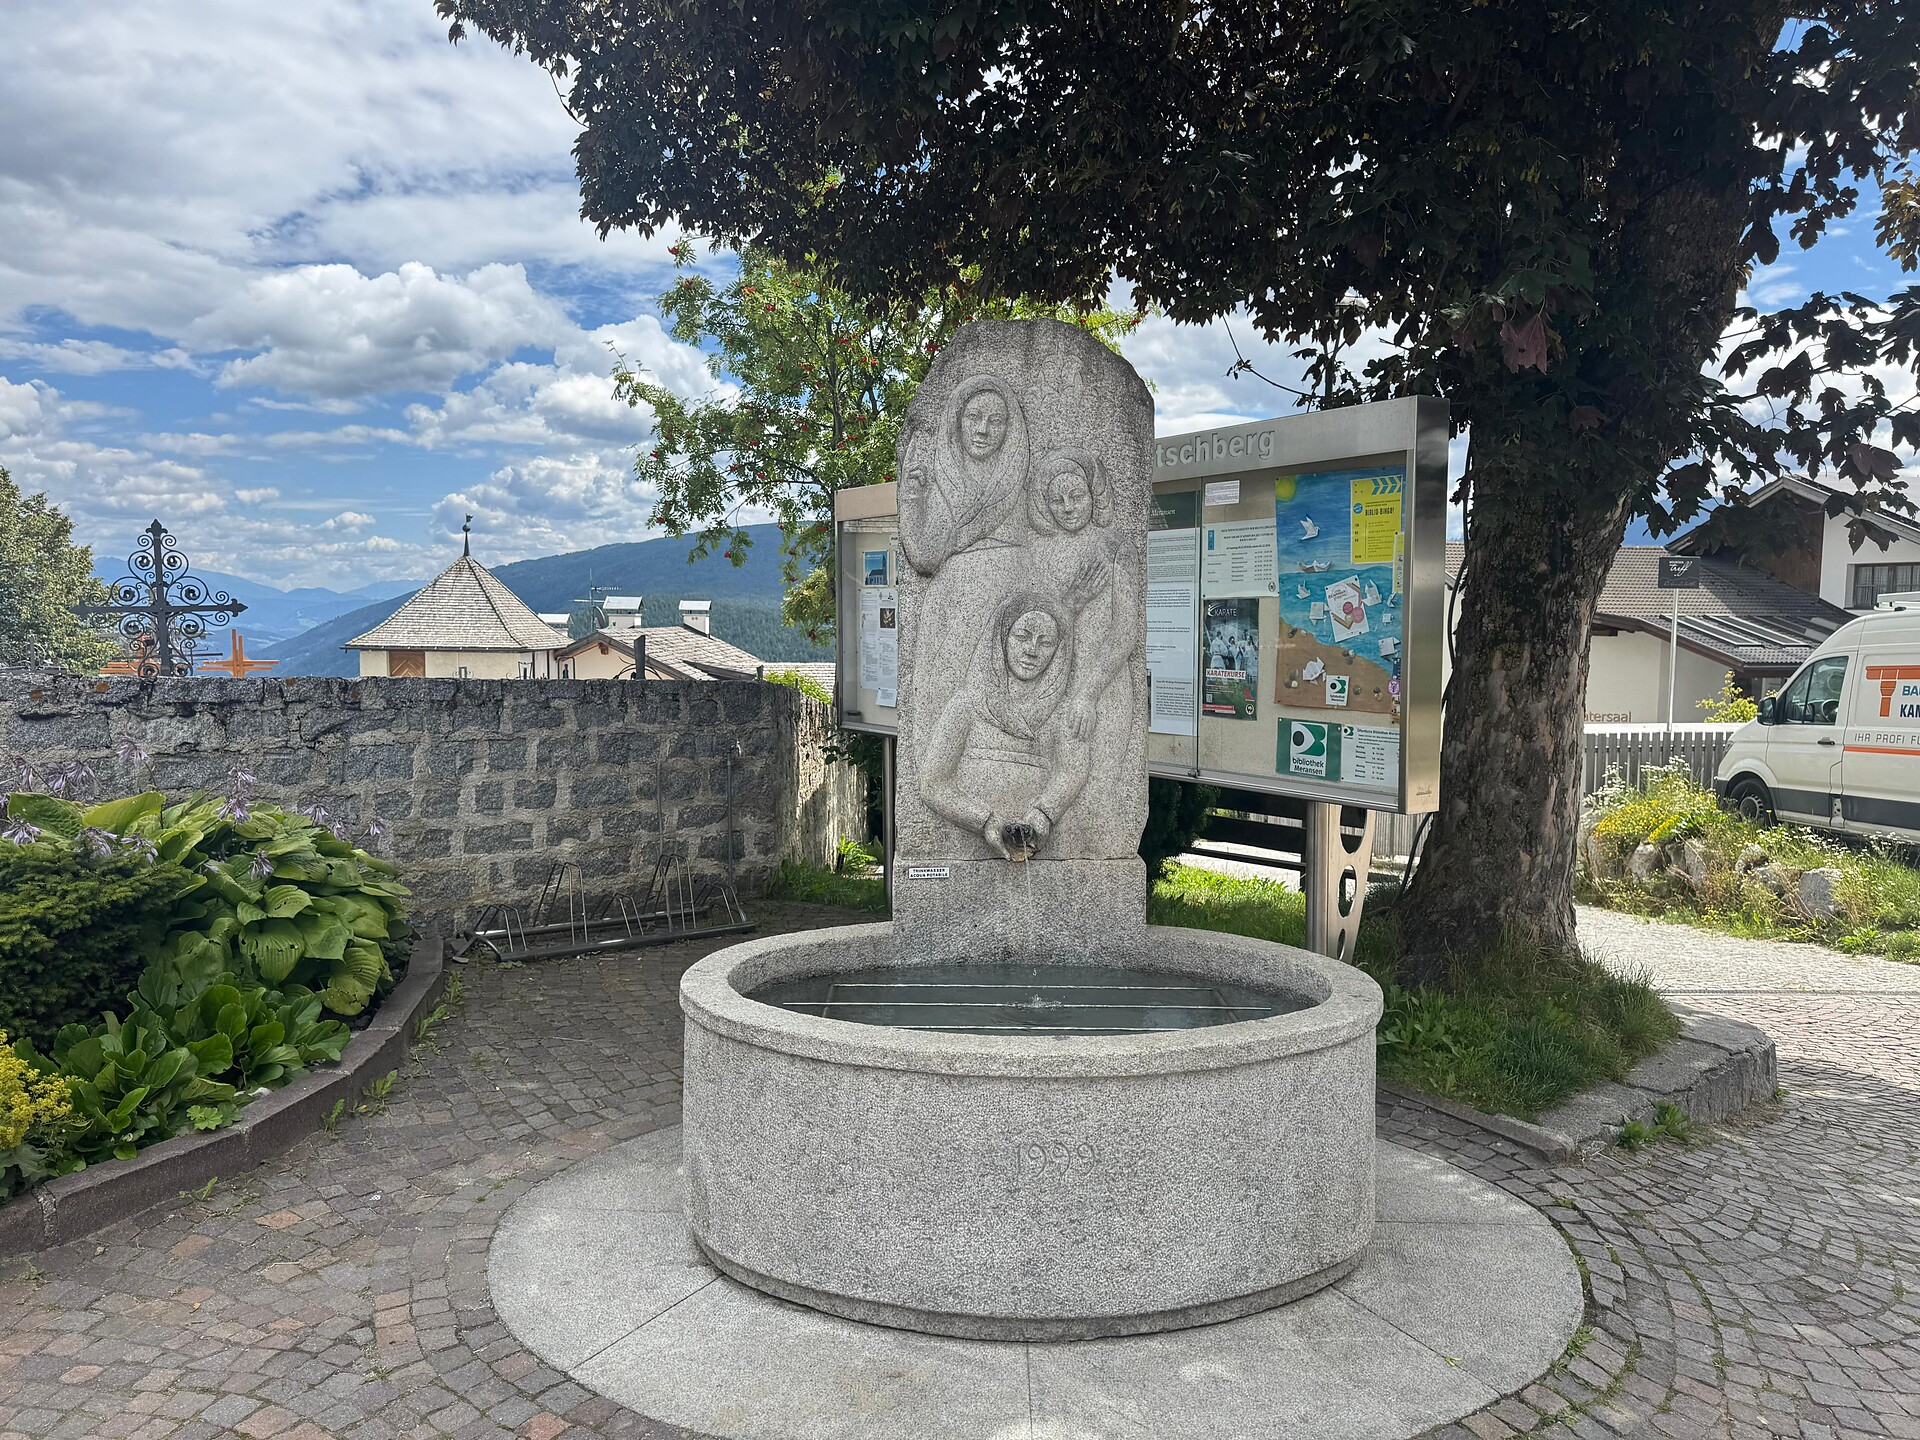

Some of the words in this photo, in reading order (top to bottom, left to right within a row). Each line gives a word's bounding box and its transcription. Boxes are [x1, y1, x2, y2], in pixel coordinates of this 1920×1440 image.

[1214, 608, 1237, 617] KARATE
[1206, 669, 1245, 679] KARATEKURSE
[1902, 685, 1920, 696] BA
[1854, 733, 1870, 742] IHR
[1876, 733, 1905, 744] PROFI
[1292, 757, 1324, 768] bibliothek
[1294, 765, 1323, 775] Meransen
[1014, 1143, 1095, 1178] 1999
